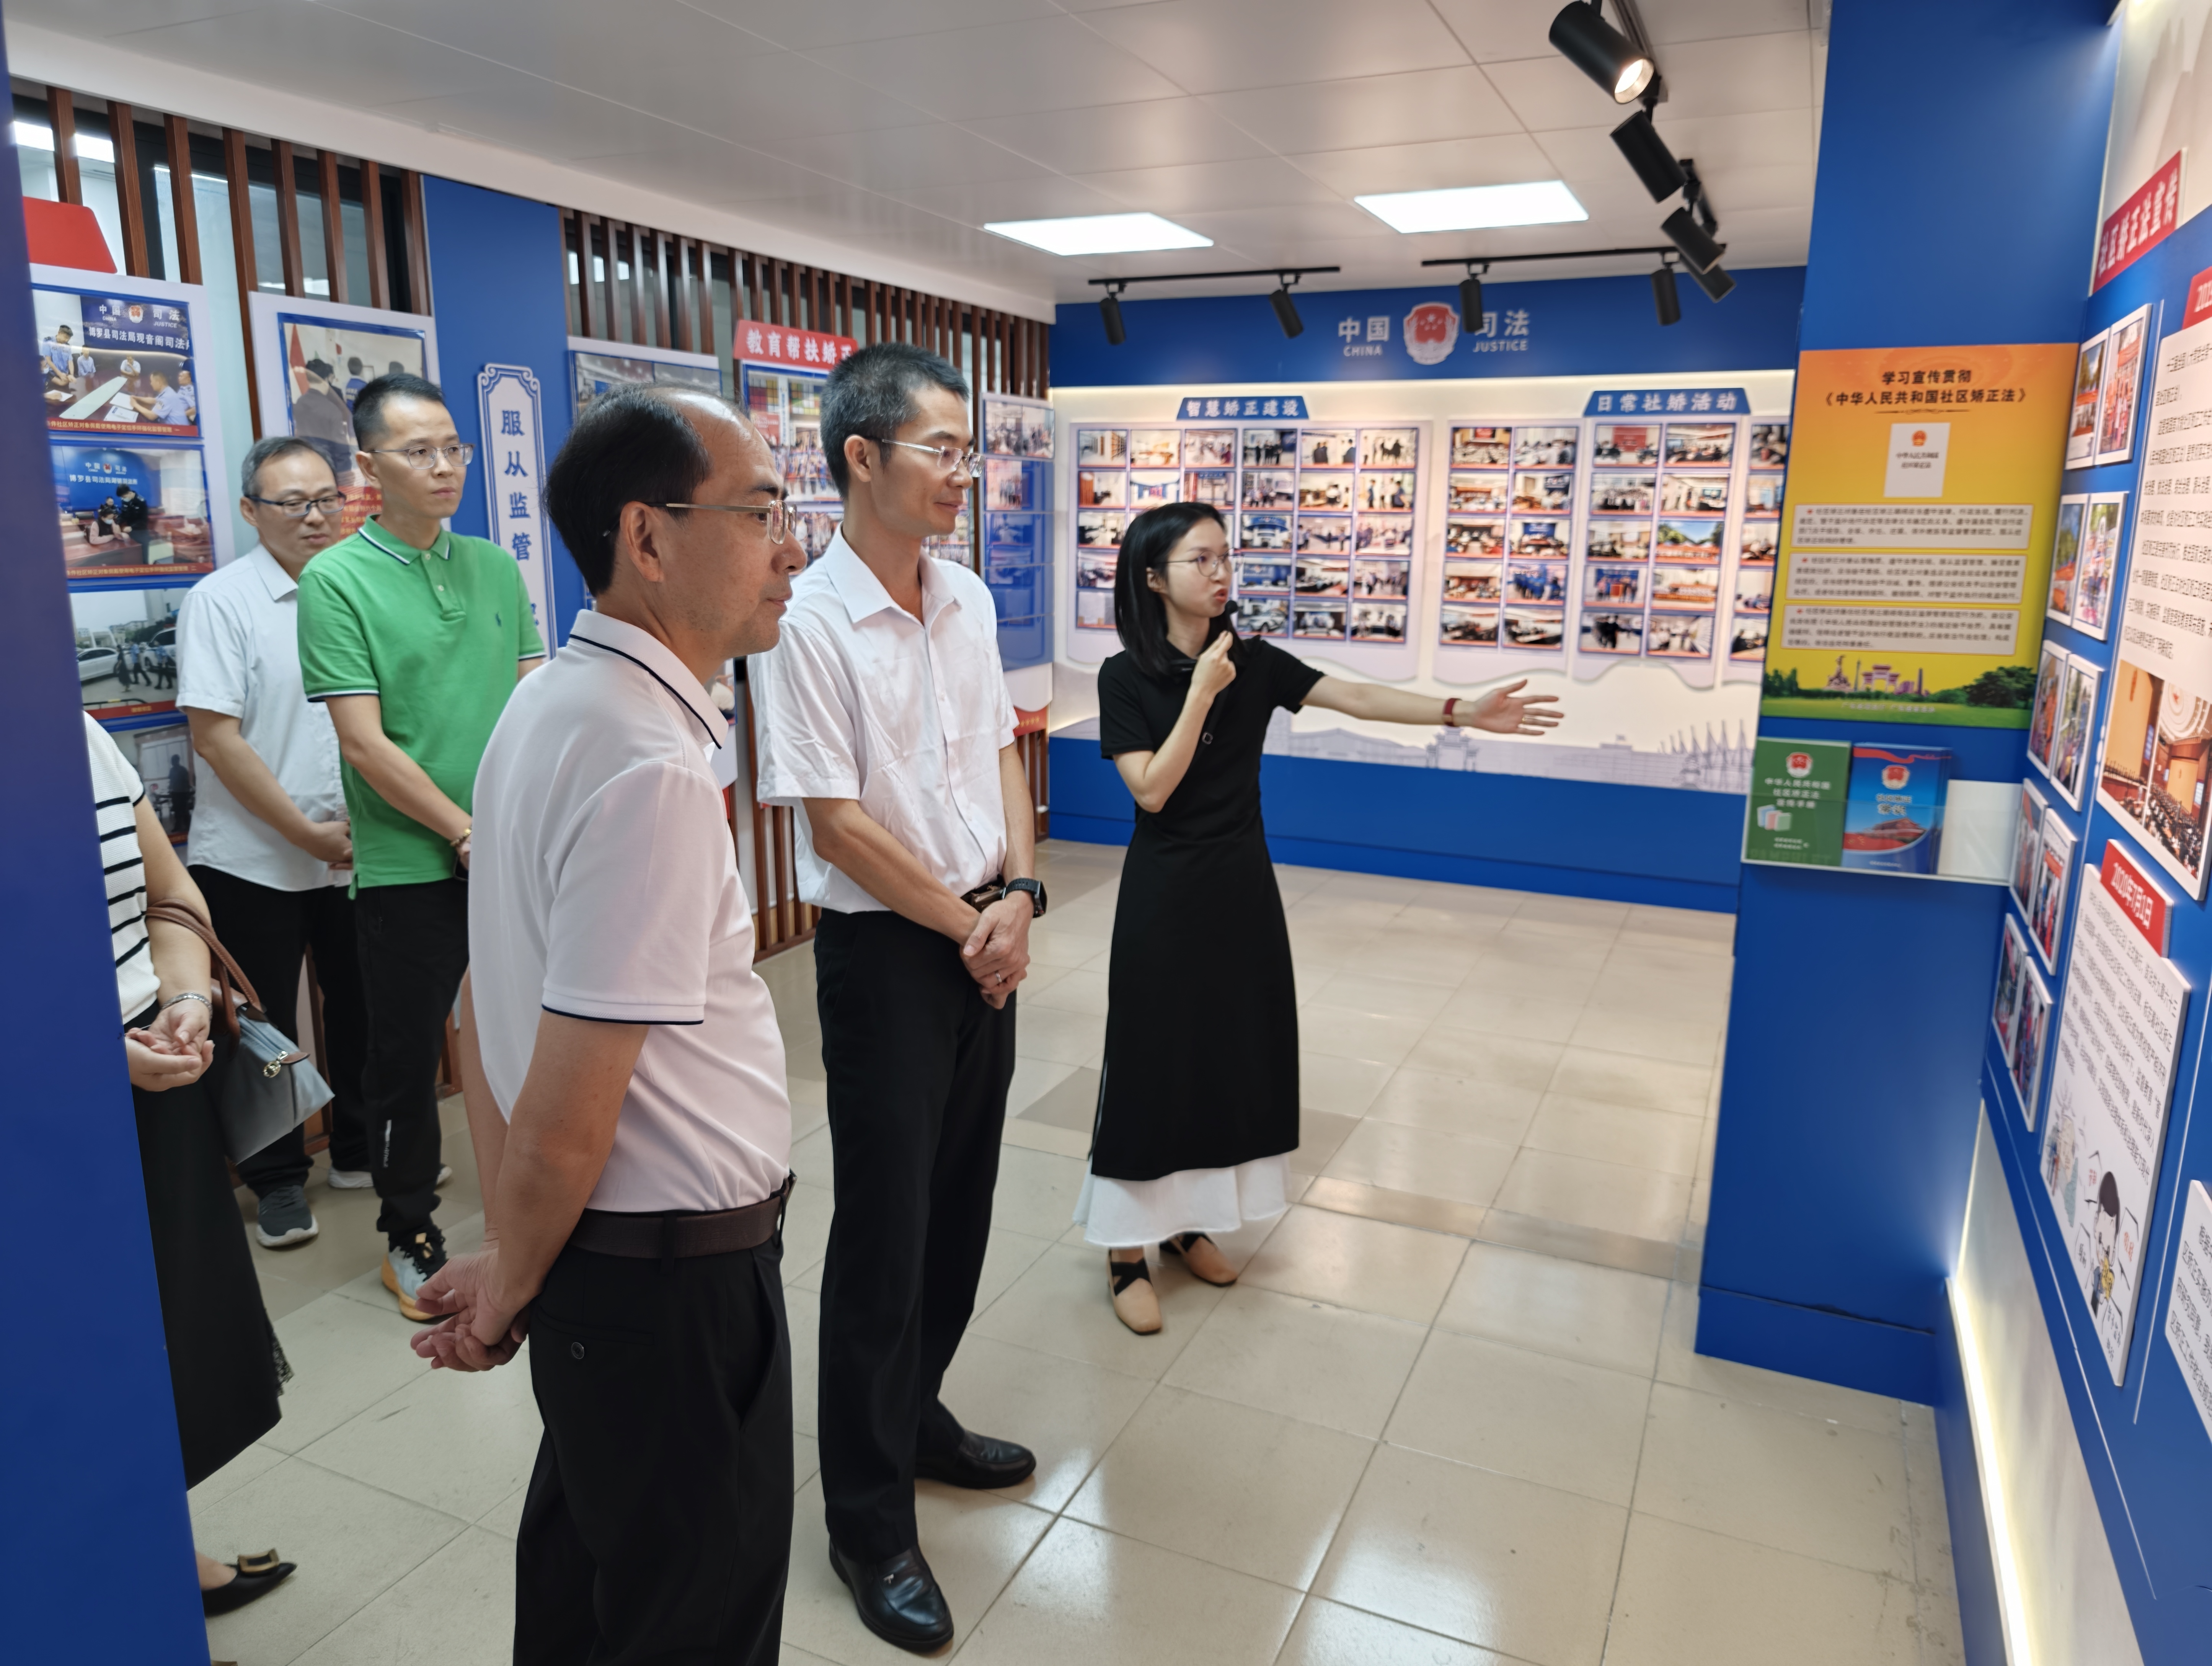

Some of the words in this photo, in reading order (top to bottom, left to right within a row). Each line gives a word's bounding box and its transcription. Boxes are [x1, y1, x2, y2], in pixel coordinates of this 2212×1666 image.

[99, 304, 120, 316] 中国
[153, 309, 180, 321] 司法
[1338, 315, 1390, 343] 中国
[1344, 345, 1382, 357] CHINA
[1473, 338, 1528, 353] JUSTICE
[1882, 370, 1971, 385] 学习宣传贯彻
[1597, 392, 1737, 412] 日常社矫活动
[1825, 389, 2026, 406] 《中华人民共和国社区矫正法》
[1186, 399, 1299, 417] 智慧矫正建设
[501, 410, 532, 561] 服从监管
[2110, 862, 2154, 930] 2020年7月1日
